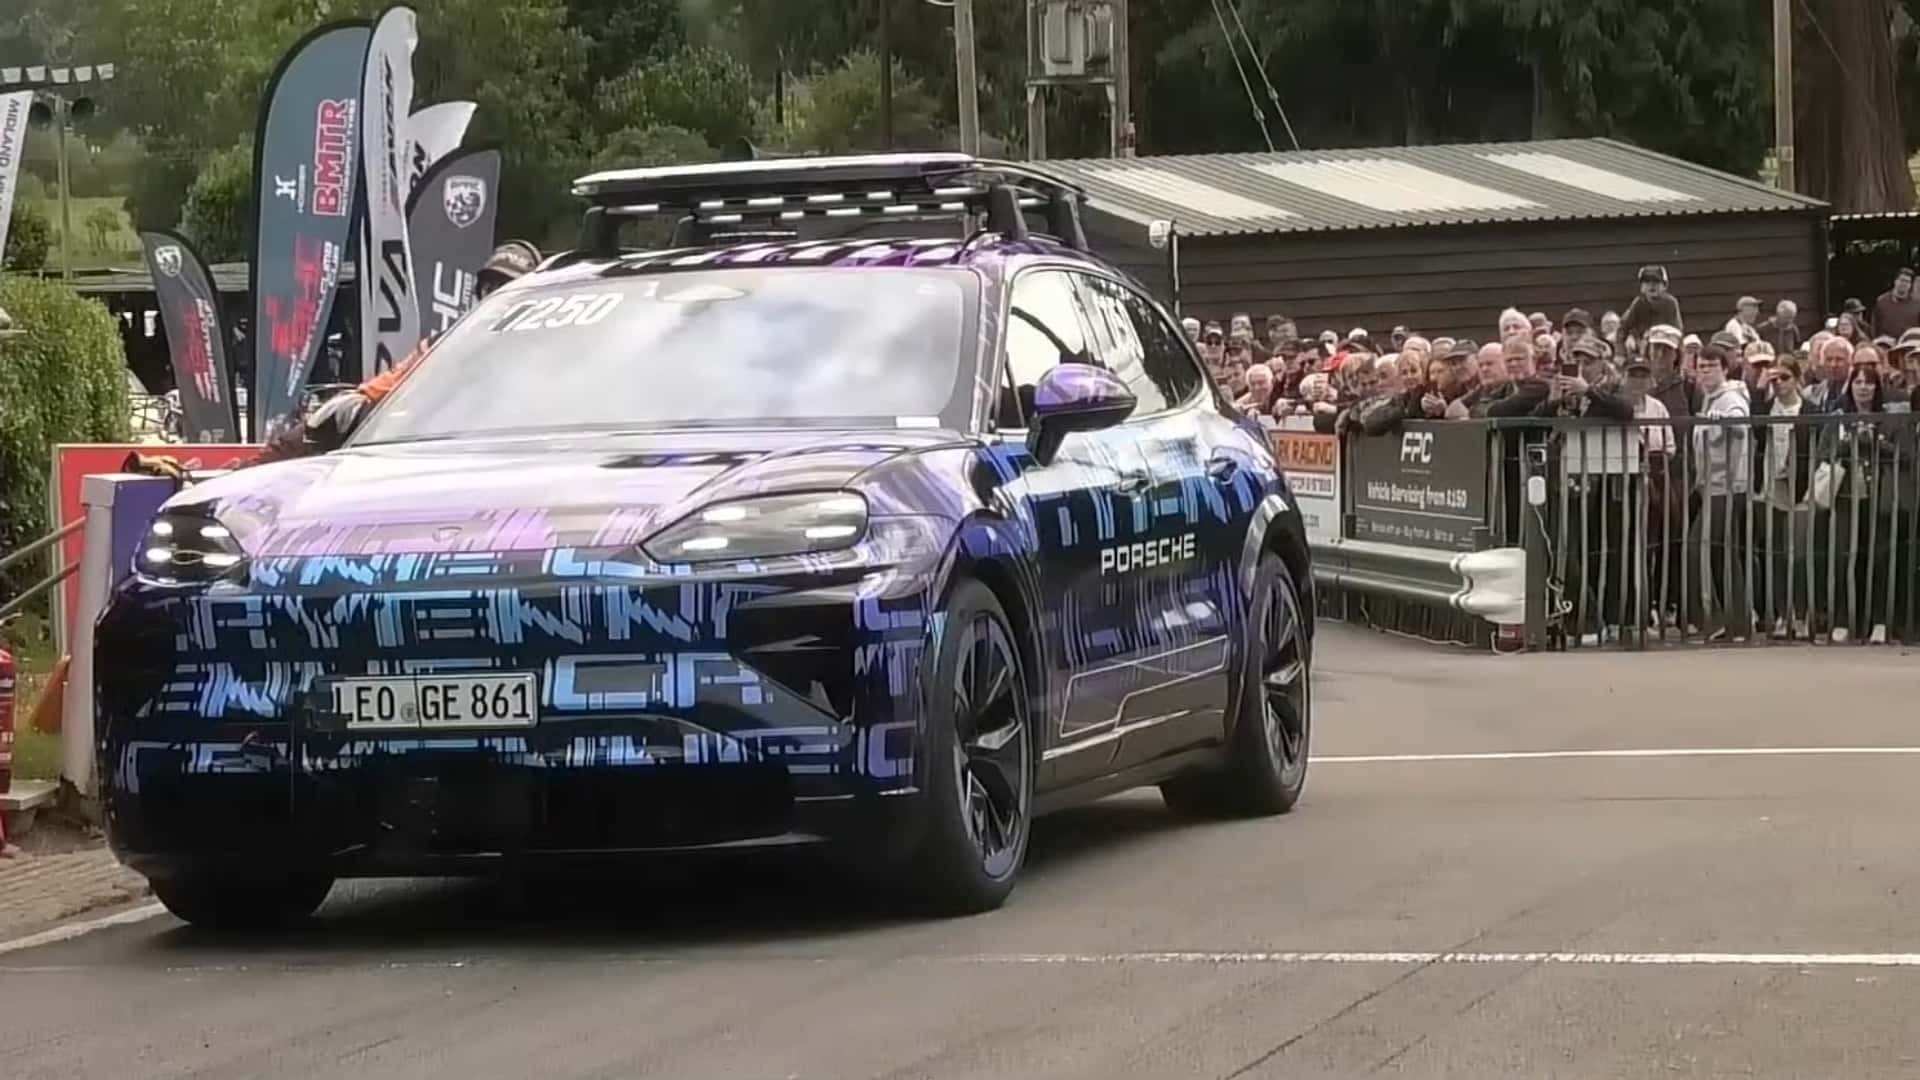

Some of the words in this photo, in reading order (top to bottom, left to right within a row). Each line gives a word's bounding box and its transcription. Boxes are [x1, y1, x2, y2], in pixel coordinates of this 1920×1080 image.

[0, 98, 20, 168] MIDLAND
[312, 98, 348, 215] BMTR
[1401, 431, 1433, 464] FPC
[1367, 481, 1390, 501] Vehicle
[1391, 484, 1425, 509] Servicing
[1426, 484, 1445, 506] from
[1101, 532, 1196, 577] PORSCHE
[334, 685, 395, 722] LEO
[421, 684, 462, 721] GE
[470, 682, 531, 720] 861
